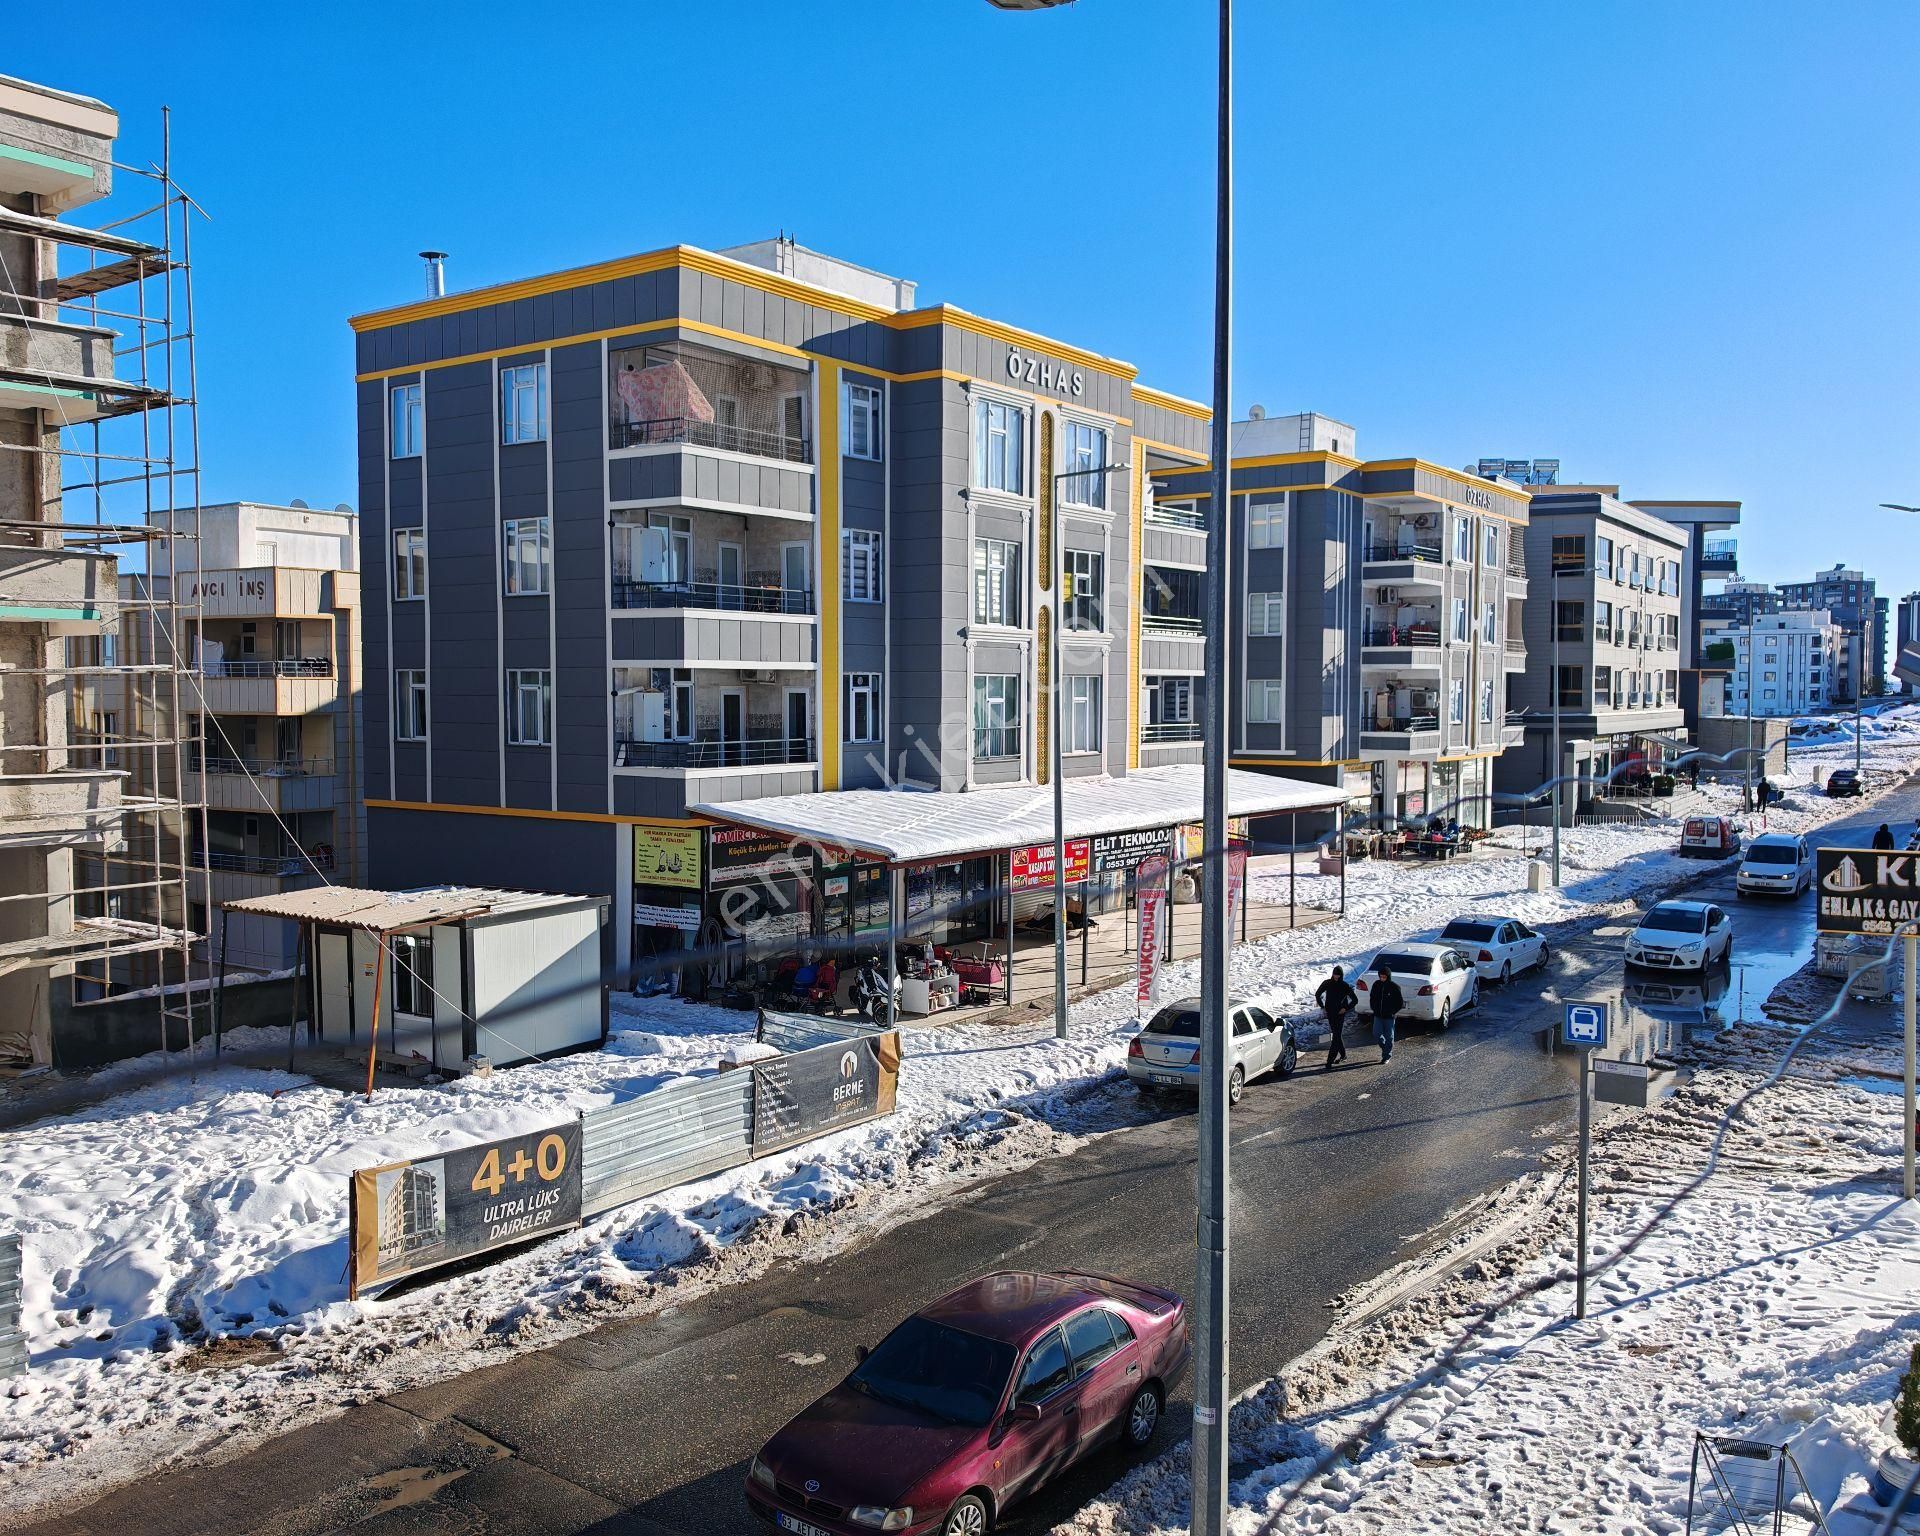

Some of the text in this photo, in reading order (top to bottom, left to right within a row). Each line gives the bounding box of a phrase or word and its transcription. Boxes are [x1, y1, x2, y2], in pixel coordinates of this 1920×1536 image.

[1007, 346, 1083, 396] ÖZHAS
[1465, 485, 1491, 509] ÖZHAS
[191, 575, 265, 600] AVCI İNŞ
[833, 1079, 864, 1102] BERME
[472, 1134, 566, 1195] 4+0
[483, 1187, 561, 1223] ULTRA LÜKS
